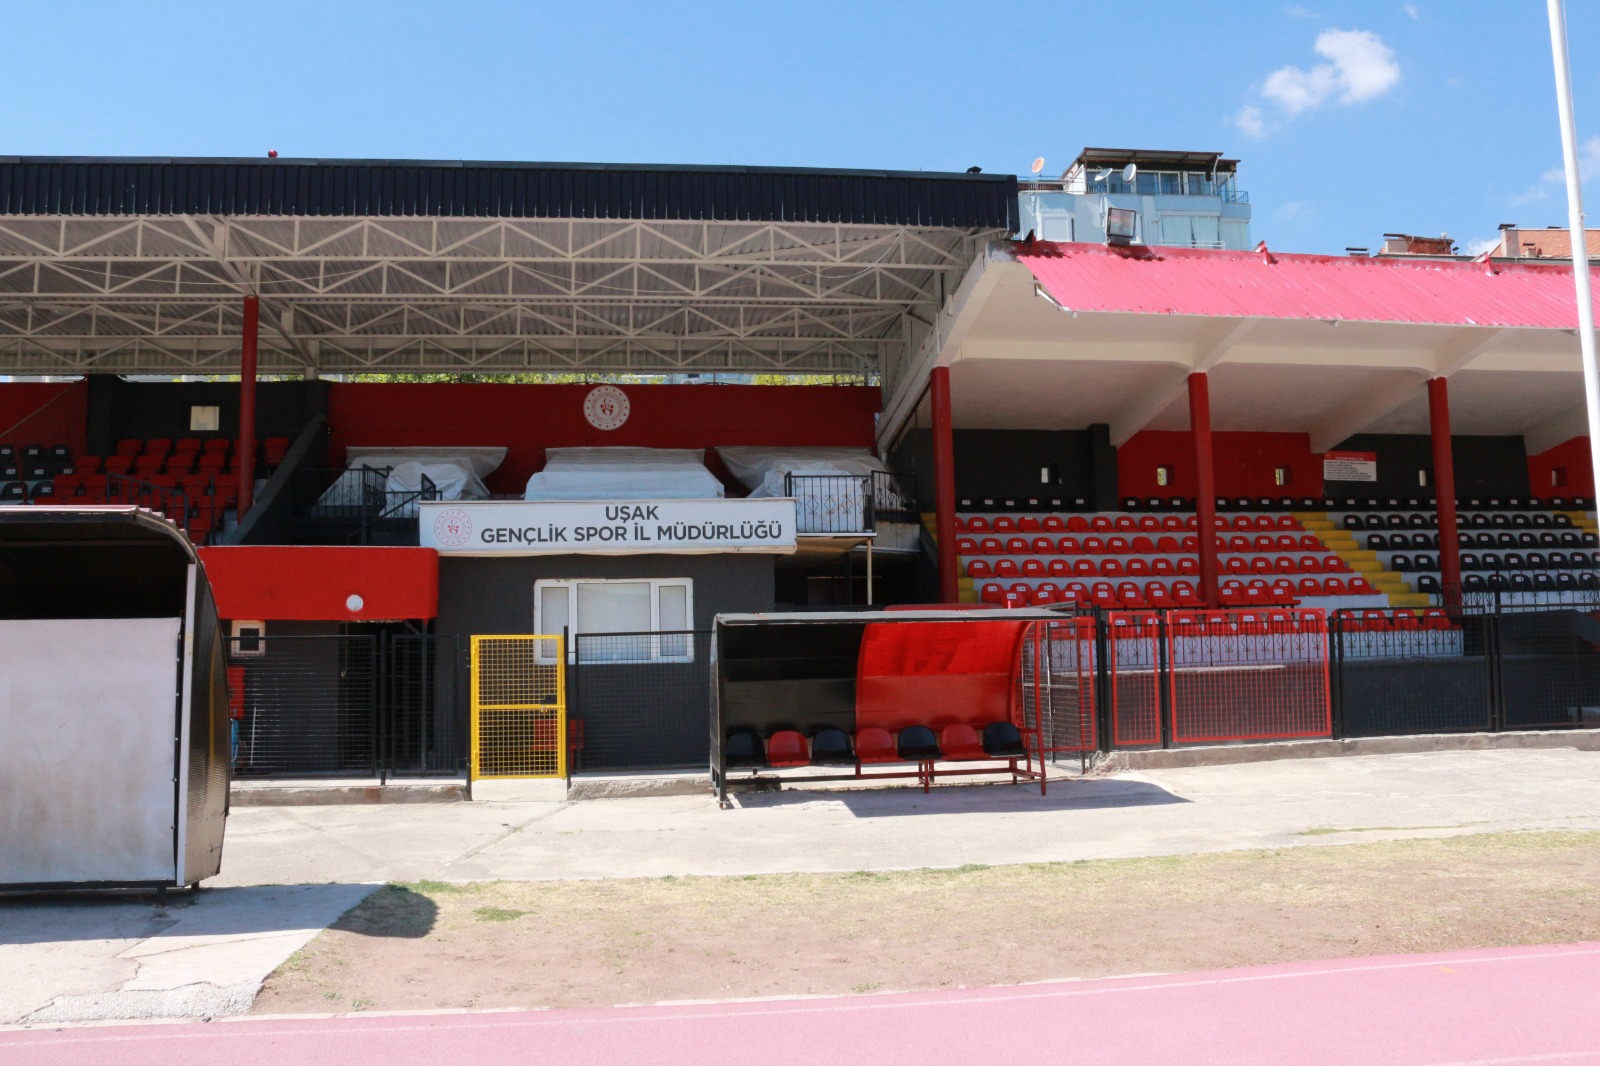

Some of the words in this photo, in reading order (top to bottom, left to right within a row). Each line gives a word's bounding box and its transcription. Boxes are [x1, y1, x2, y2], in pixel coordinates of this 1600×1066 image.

[605, 505, 659, 523] UŞAK
[481, 523, 568, 545] GENÇLİK
[574, 526, 627, 542] SPOR
[634, 521, 651, 541] İL
[657, 519, 783, 541] MÜDÜRLÜĞÜ
